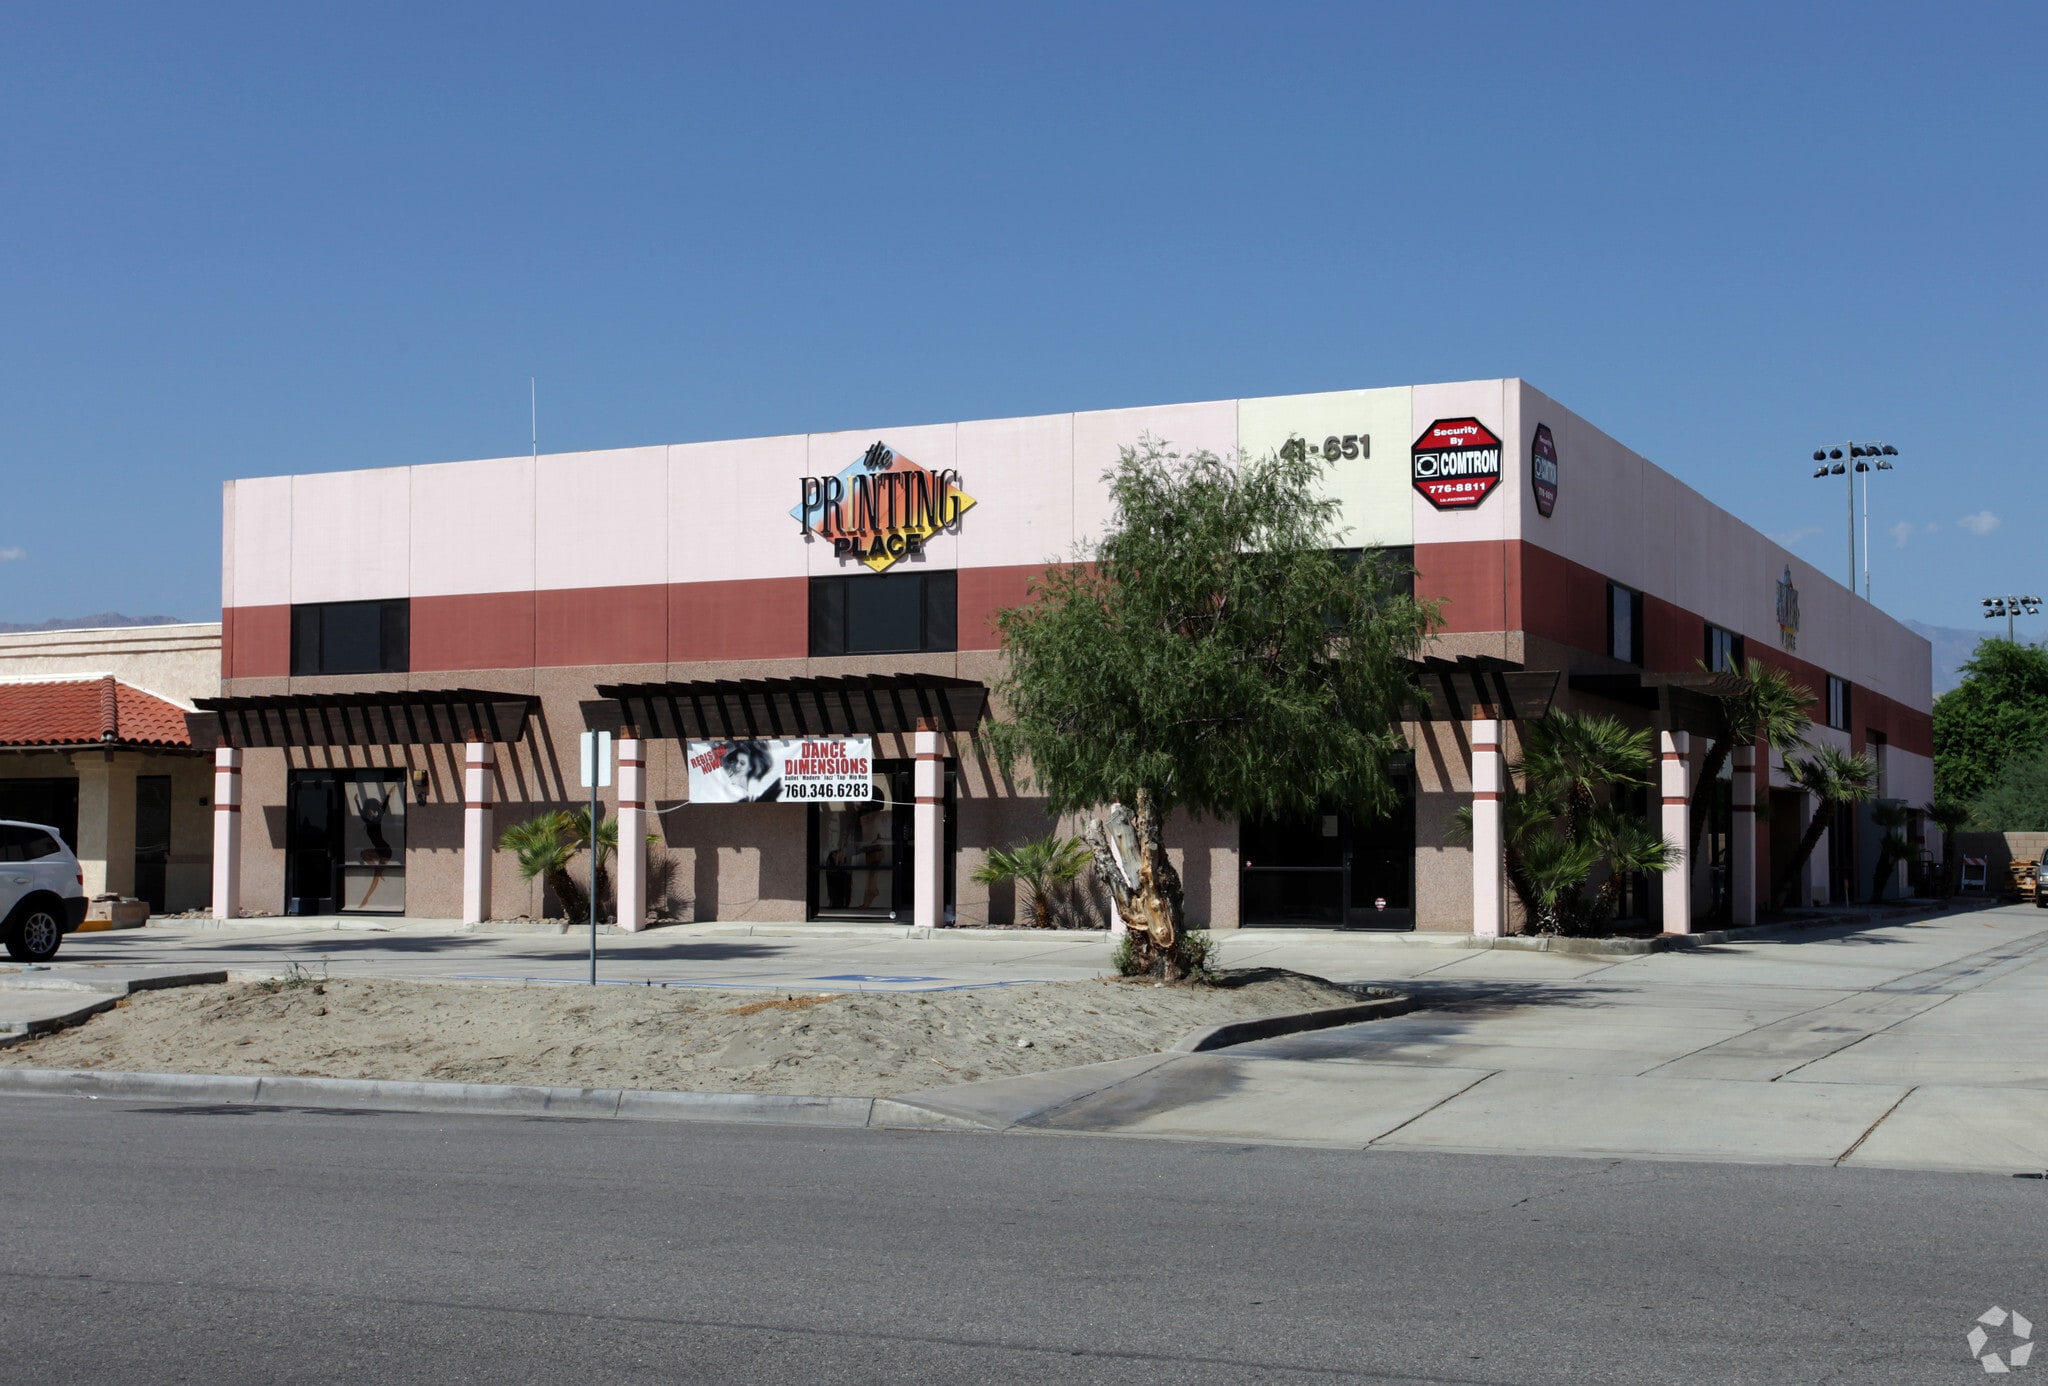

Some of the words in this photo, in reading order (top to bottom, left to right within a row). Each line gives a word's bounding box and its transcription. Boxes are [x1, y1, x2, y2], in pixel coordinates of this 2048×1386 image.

[1433, 426, 1478, 437] Security
[1280, 434, 1370, 463] 41-651
[1450, 437, 1464, 446] By
[863, 440, 893, 468] the
[1440, 449, 1498, 476] COMTRON
[1429, 482, 1486, 494] 776-8811
[799, 468, 961, 536] PRINTING
[834, 533, 923, 558] PLACE
[801, 741, 847, 759] DANCE
[784, 757, 868, 775] DIMENSIONS
[784, 783, 869, 798] 760.346.6283
